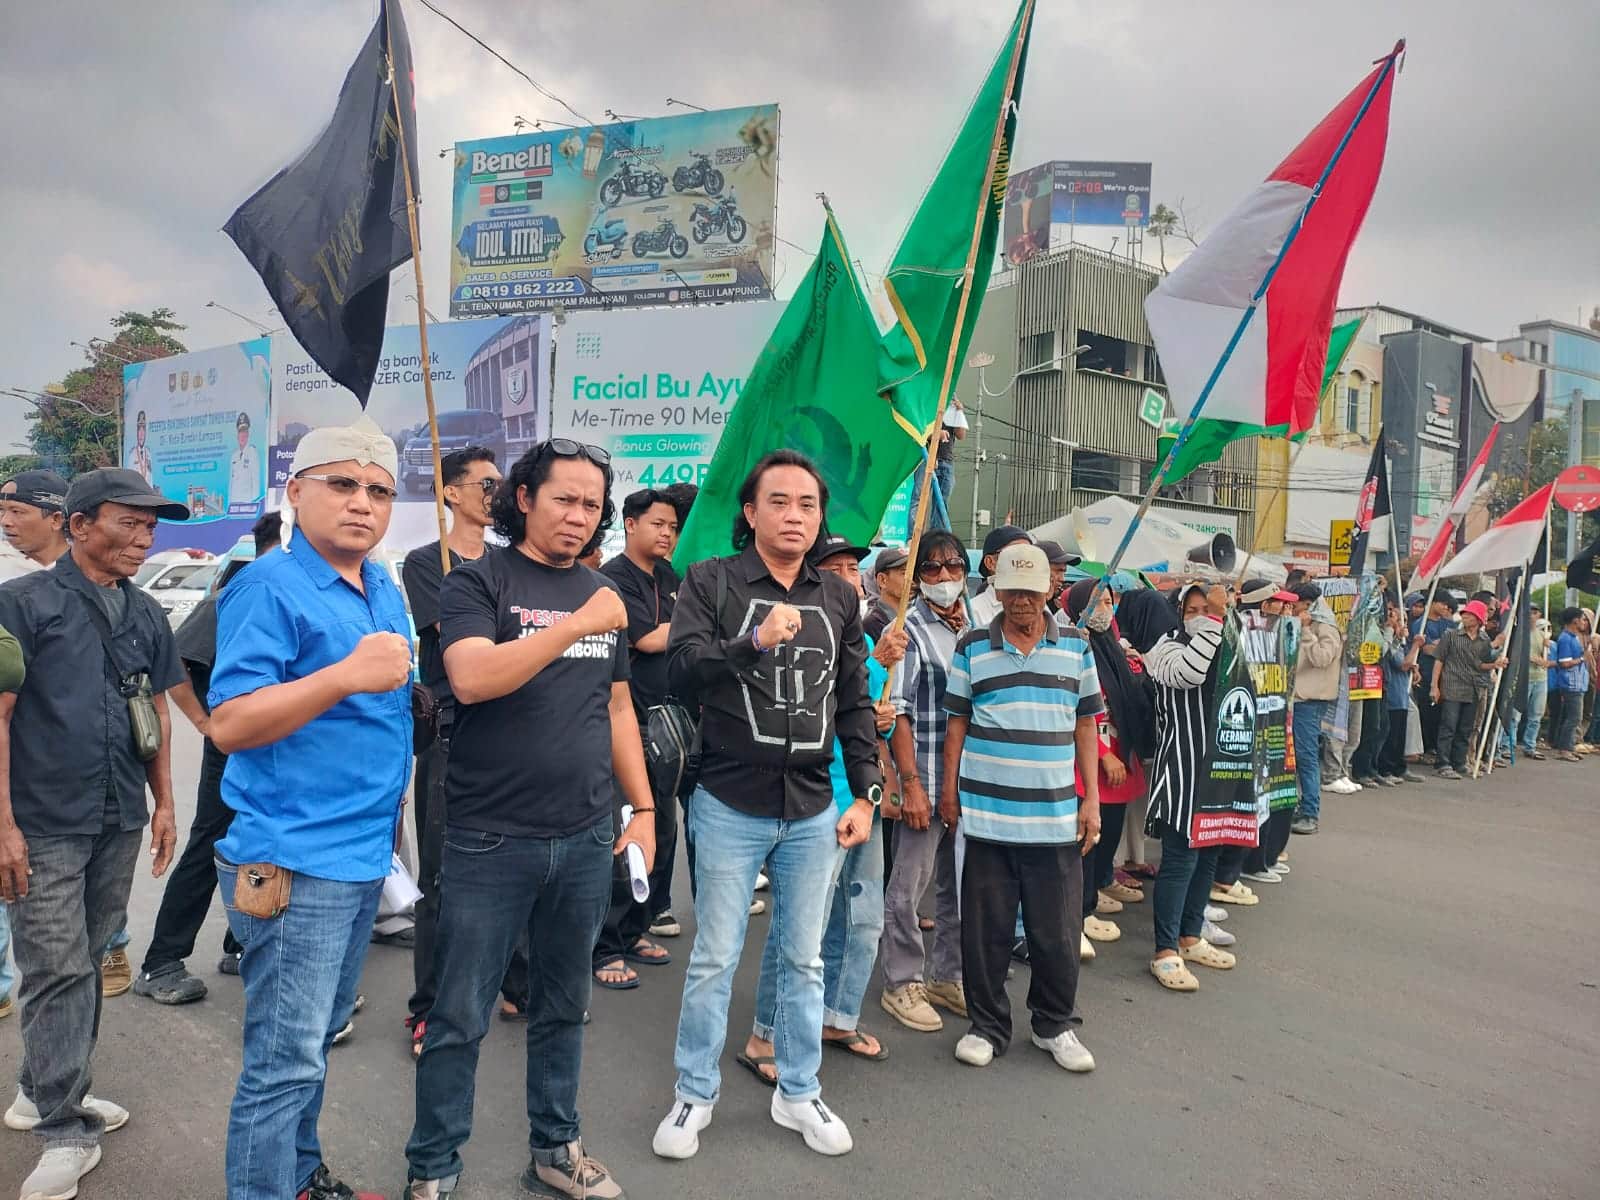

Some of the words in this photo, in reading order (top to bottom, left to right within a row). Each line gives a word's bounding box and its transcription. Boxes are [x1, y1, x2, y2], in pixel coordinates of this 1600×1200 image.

[471, 143, 552, 174] Benelli
[1128, 184, 1150, 193] Open
[475, 230, 506, 259] IDUL
[510, 269, 553, 280] SERVICE
[473, 285, 509, 298] 0819
[514, 283, 541, 295] 862
[546, 281, 575, 294] 222
[717, 286, 760, 297] LAMPUNG
[286, 361, 313, 376] Pasti
[285, 379, 328, 392] dengan
[403, 369, 456, 383] Carenz.
[572, 374, 648, 401] Facial
[656, 373, 690, 399] Bu
[571, 407, 655, 428] Me-Time
[660, 406, 686, 426] 90
[615, 439, 653, 452] Bonus
[275, 470, 288, 482] Rp
